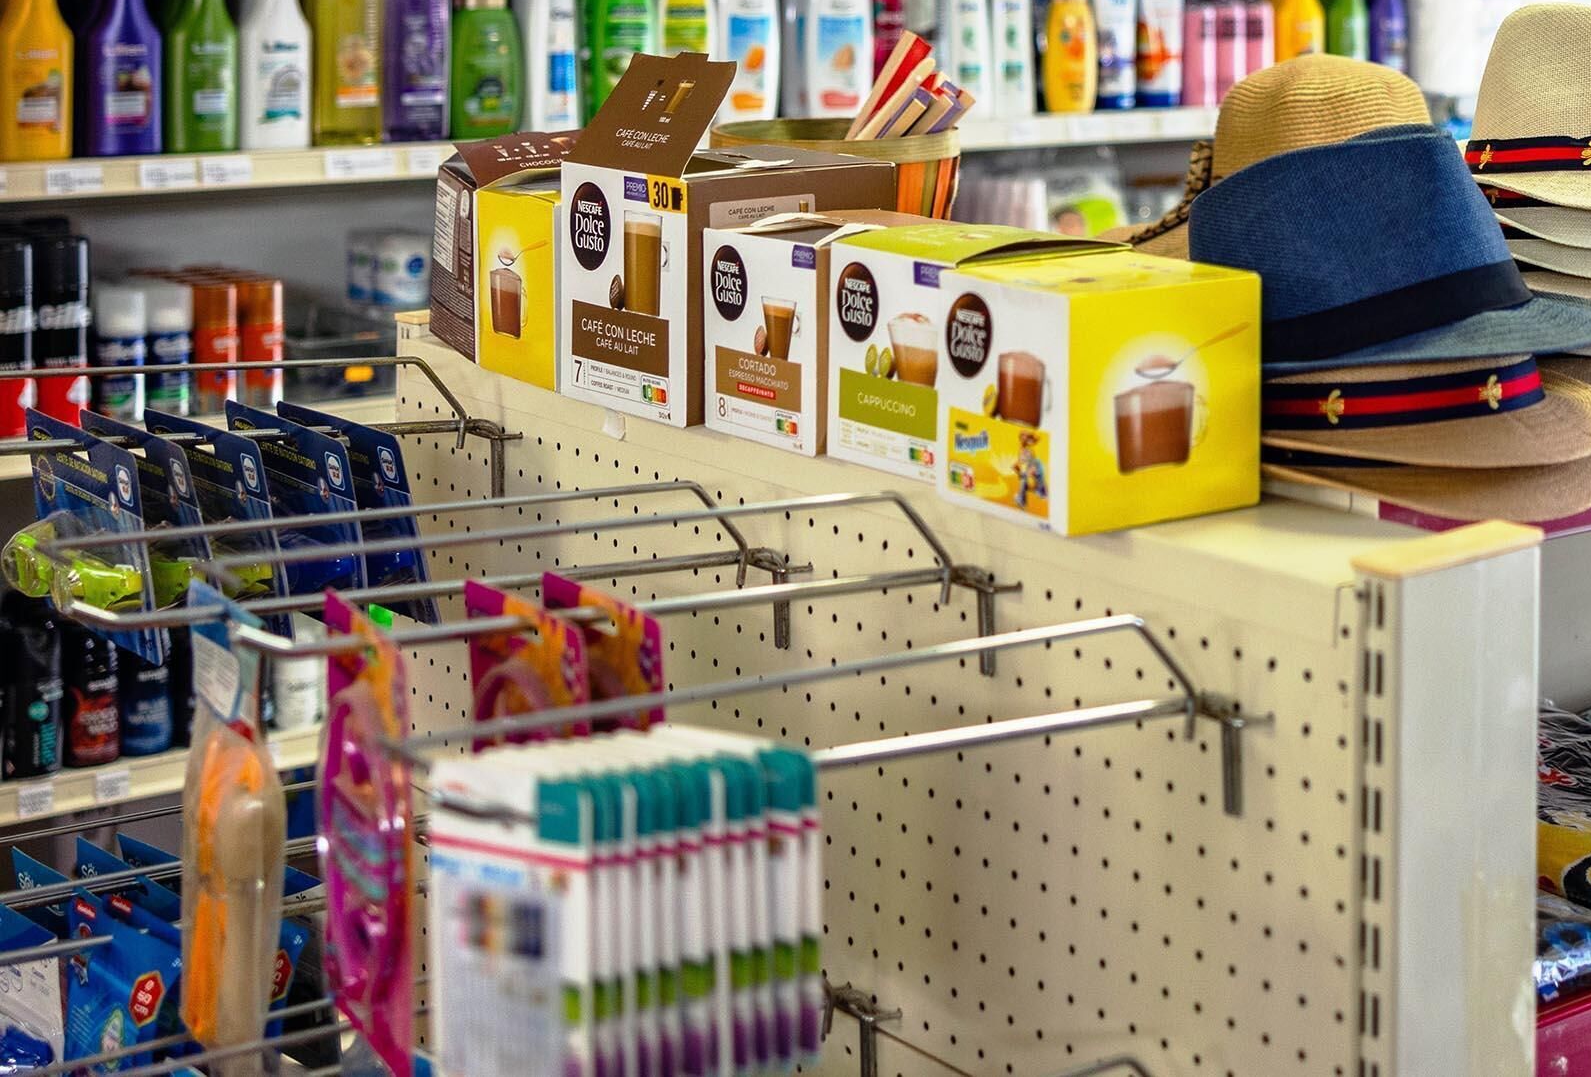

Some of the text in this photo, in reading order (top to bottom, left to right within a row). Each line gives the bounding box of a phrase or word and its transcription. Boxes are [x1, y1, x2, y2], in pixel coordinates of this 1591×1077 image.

[634, 132, 648, 140] CON
[647, 133, 670, 143] LECHE
[653, 181, 669, 209] 30
[575, 213, 604, 236] Dolce
[575, 230, 604, 252] Gusto
[715, 272, 742, 292] Dolce
[716, 286, 742, 305] Gusto
[842, 289, 873, 312] Dolce
[842, 304, 873, 326] Gusto
[581, 318, 656, 347] CAFÉ CON LECHE
[596, 337, 639, 355] CAFÉ AU LAIT
[574, 359, 583, 382] 7
[739, 357, 776, 376] CORTADO
[719, 396, 726, 417] 8
[857, 392, 916, 417] CAPPUCCINO
